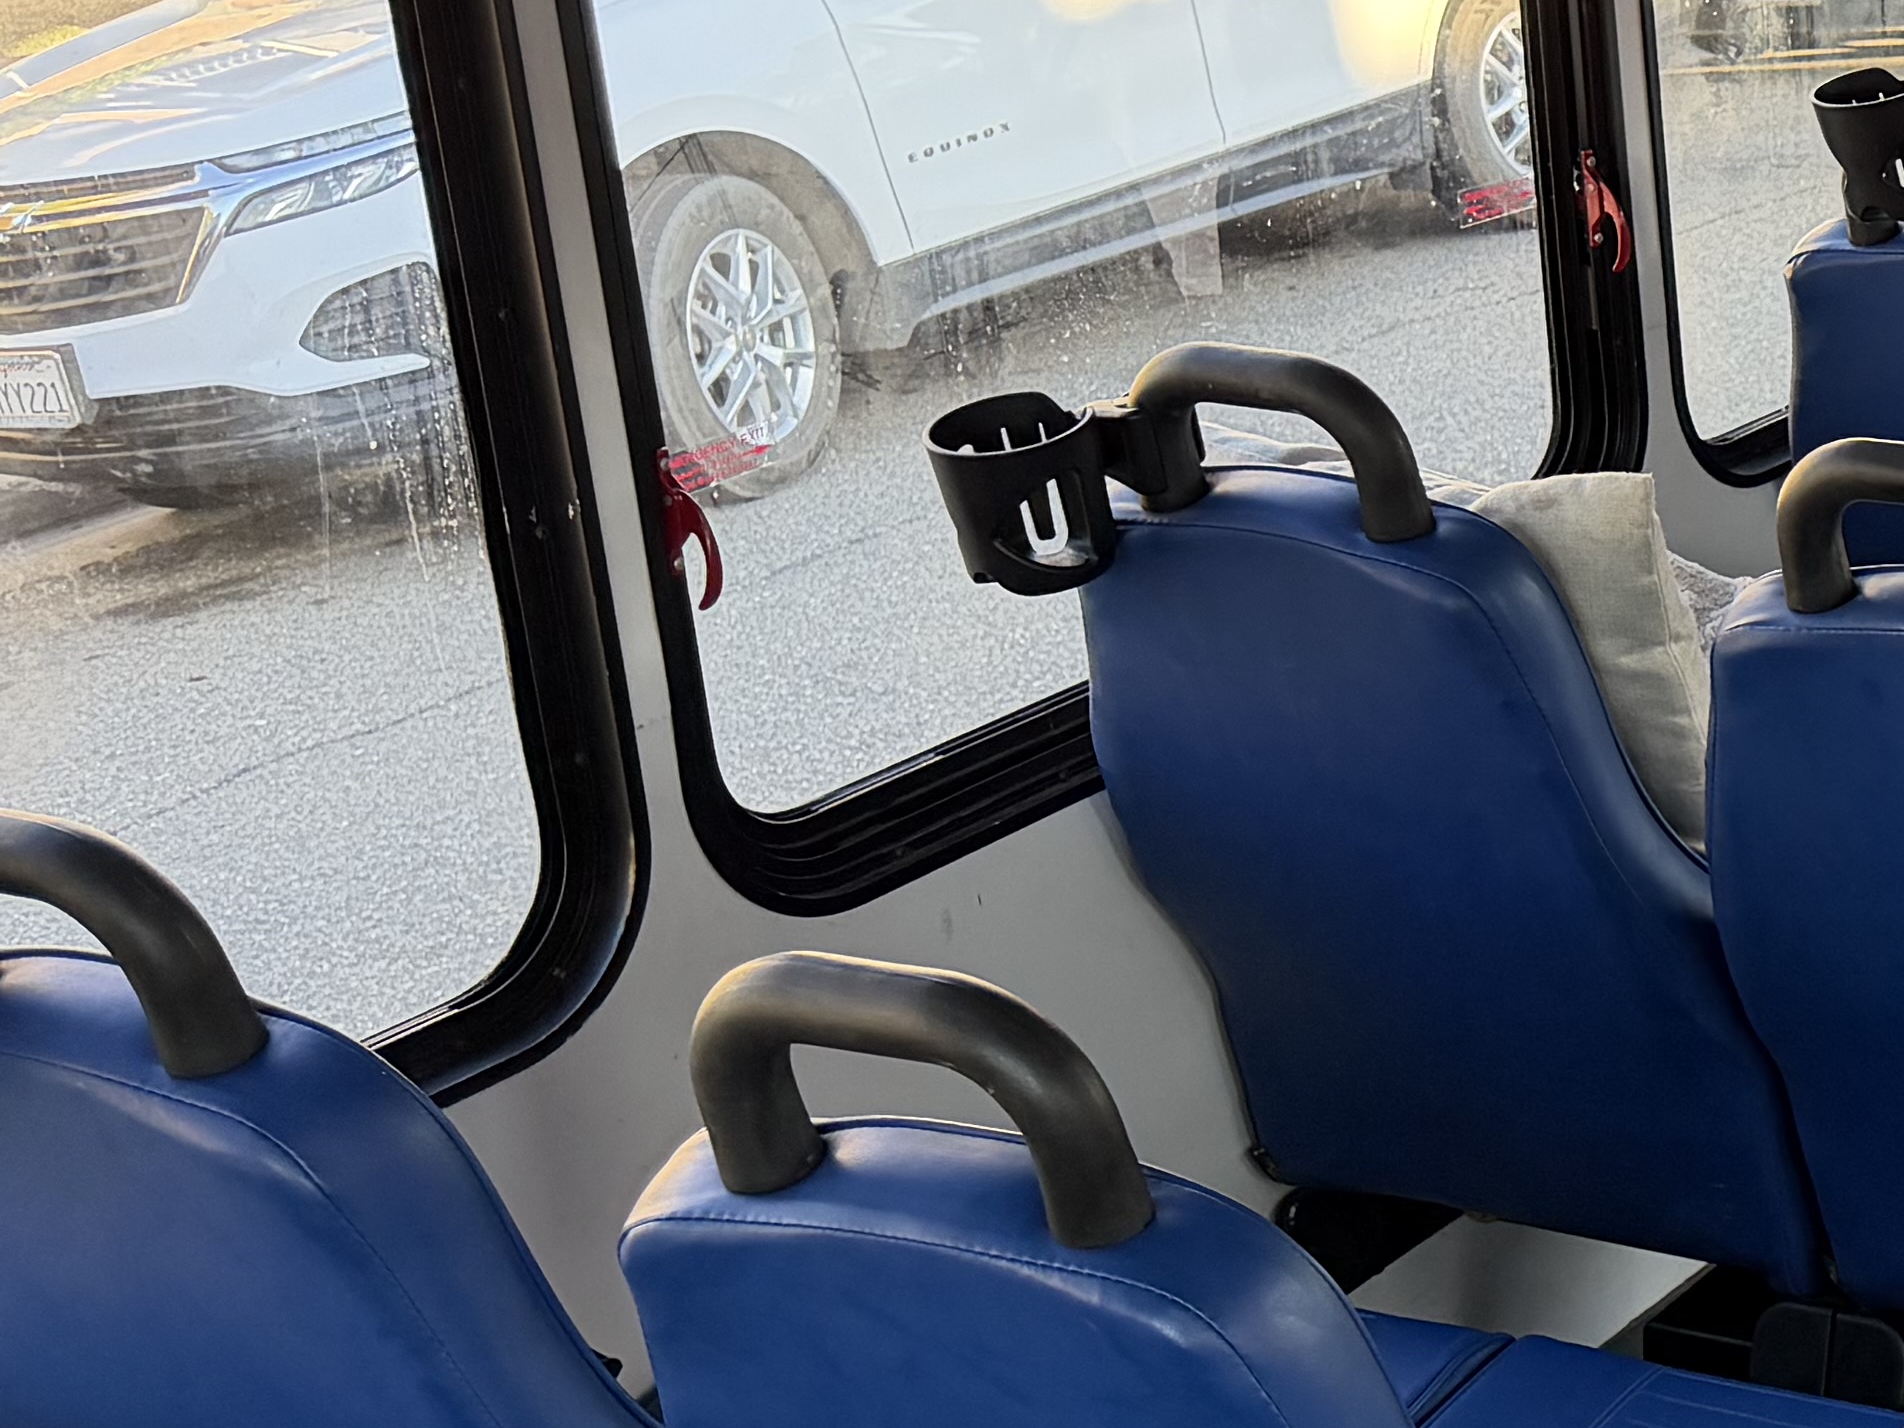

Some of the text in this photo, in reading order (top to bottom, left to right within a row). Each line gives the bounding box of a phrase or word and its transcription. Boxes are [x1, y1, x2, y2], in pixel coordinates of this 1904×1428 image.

[908, 122, 1010, 163] EQUINOX
[0, 382, 69, 414] YY221
[739, 427, 765, 446] EXIT
